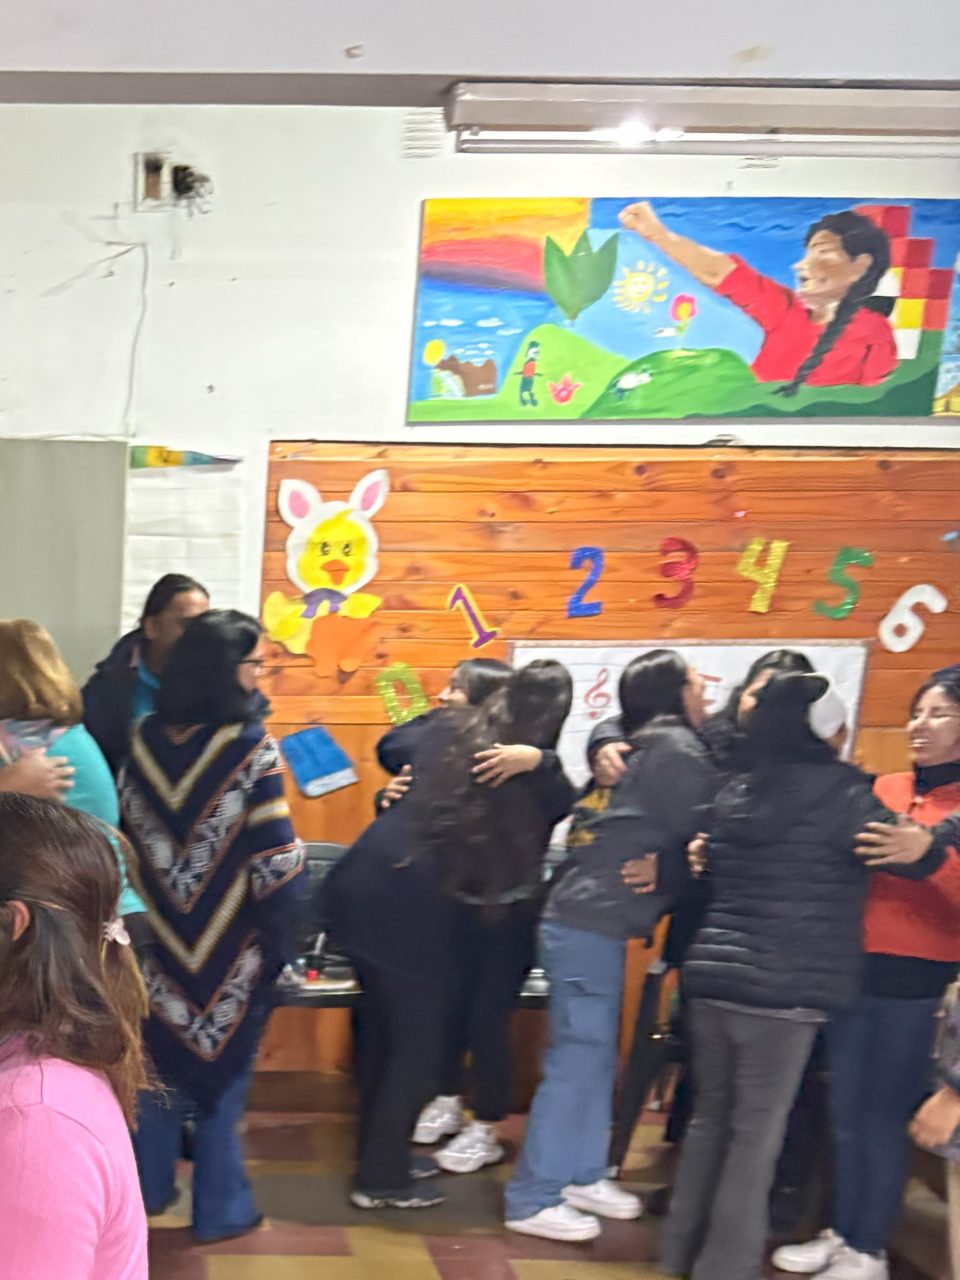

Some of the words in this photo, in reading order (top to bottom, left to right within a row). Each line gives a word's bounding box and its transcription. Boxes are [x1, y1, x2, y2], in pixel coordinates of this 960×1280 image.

[446, 584, 500, 649] 1
[567, 546, 605, 618] 2
[653, 537, 698, 608] 3
[736, 537, 789, 613] 4
[811, 547, 875, 620] 5
[878, 584, 948, 652] 6
